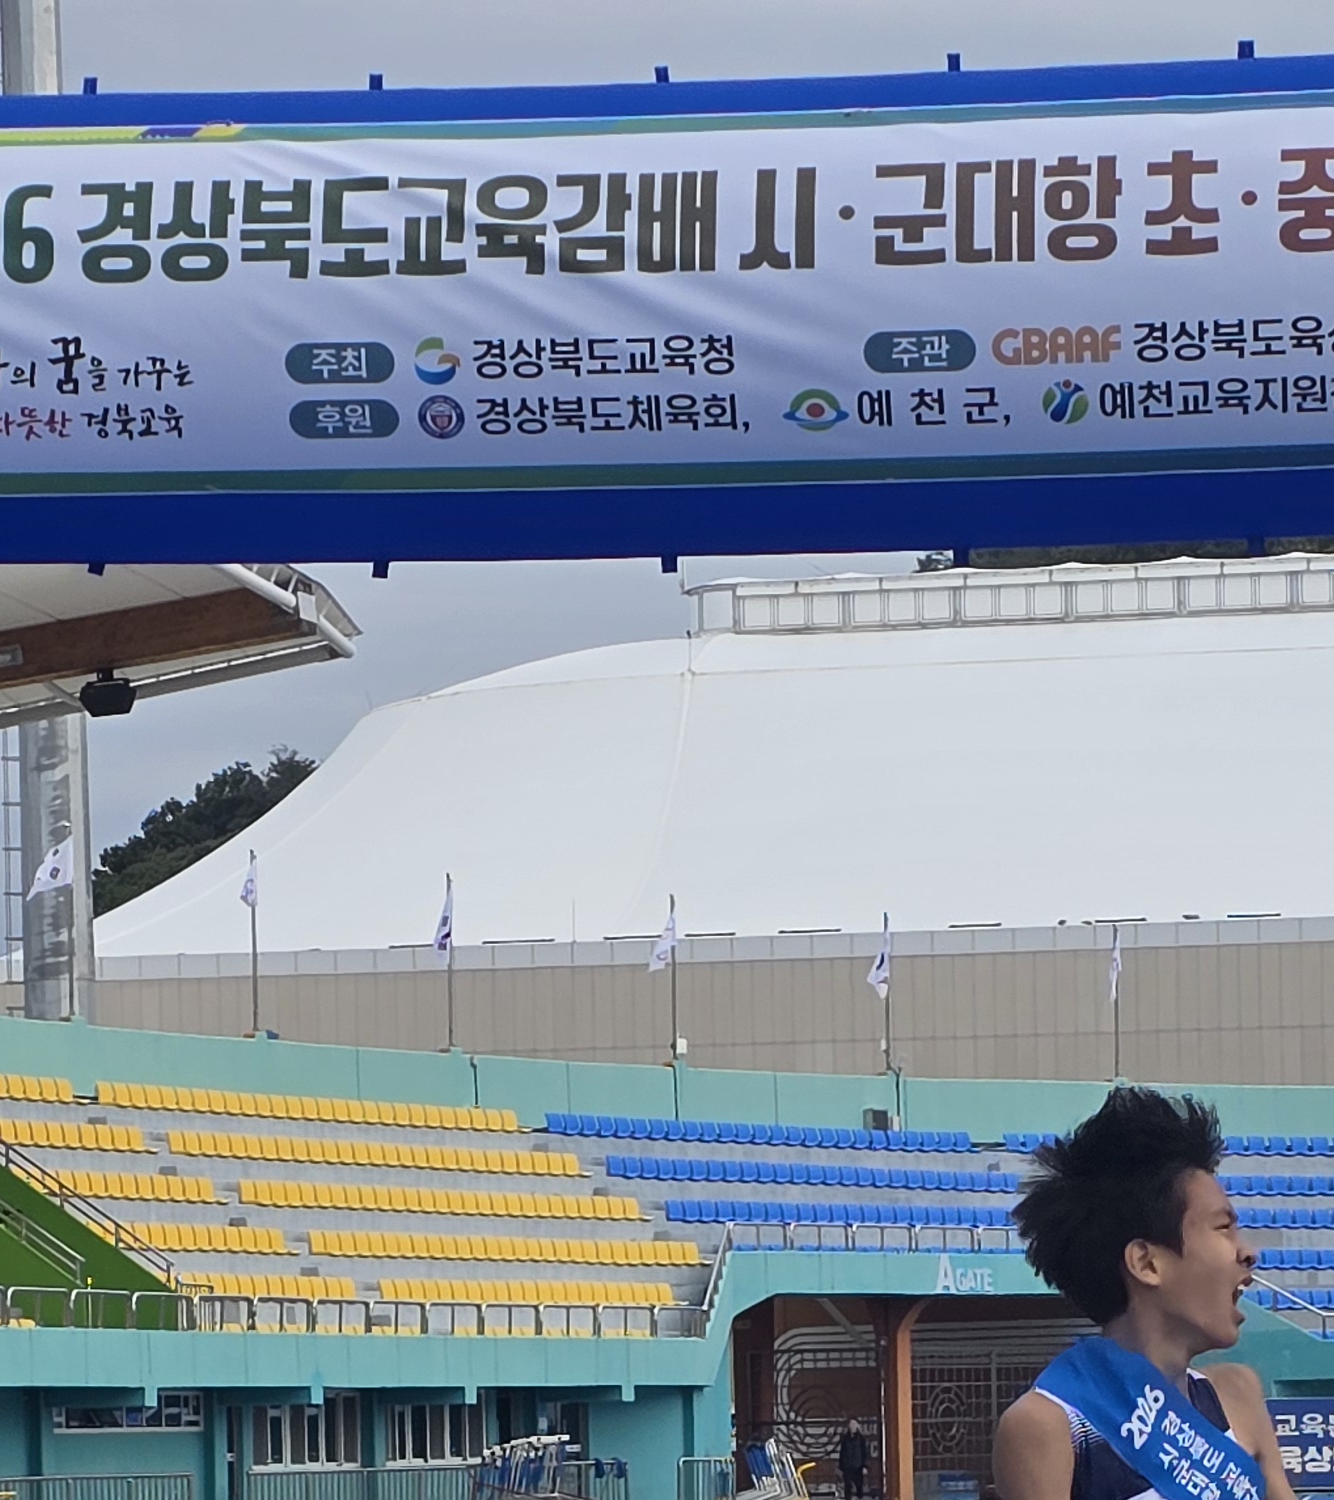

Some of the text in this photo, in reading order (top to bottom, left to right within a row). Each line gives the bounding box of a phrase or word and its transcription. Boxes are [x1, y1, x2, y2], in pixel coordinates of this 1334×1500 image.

[77, 169, 719, 284] 경상북도교육감배
[48, 337, 108, 396] 꿈을
[117, 356, 196, 390] 가꾸는
[311, 334, 737, 380] 주최 경상북도교육청
[891, 335, 952, 368] 주관
[990, 324, 1123, 366] GBAAF
[81, 403, 185, 440] 경북교육
[316, 403, 373, 436] 후원
[475, 394, 751, 436] 경상북도체육회,
